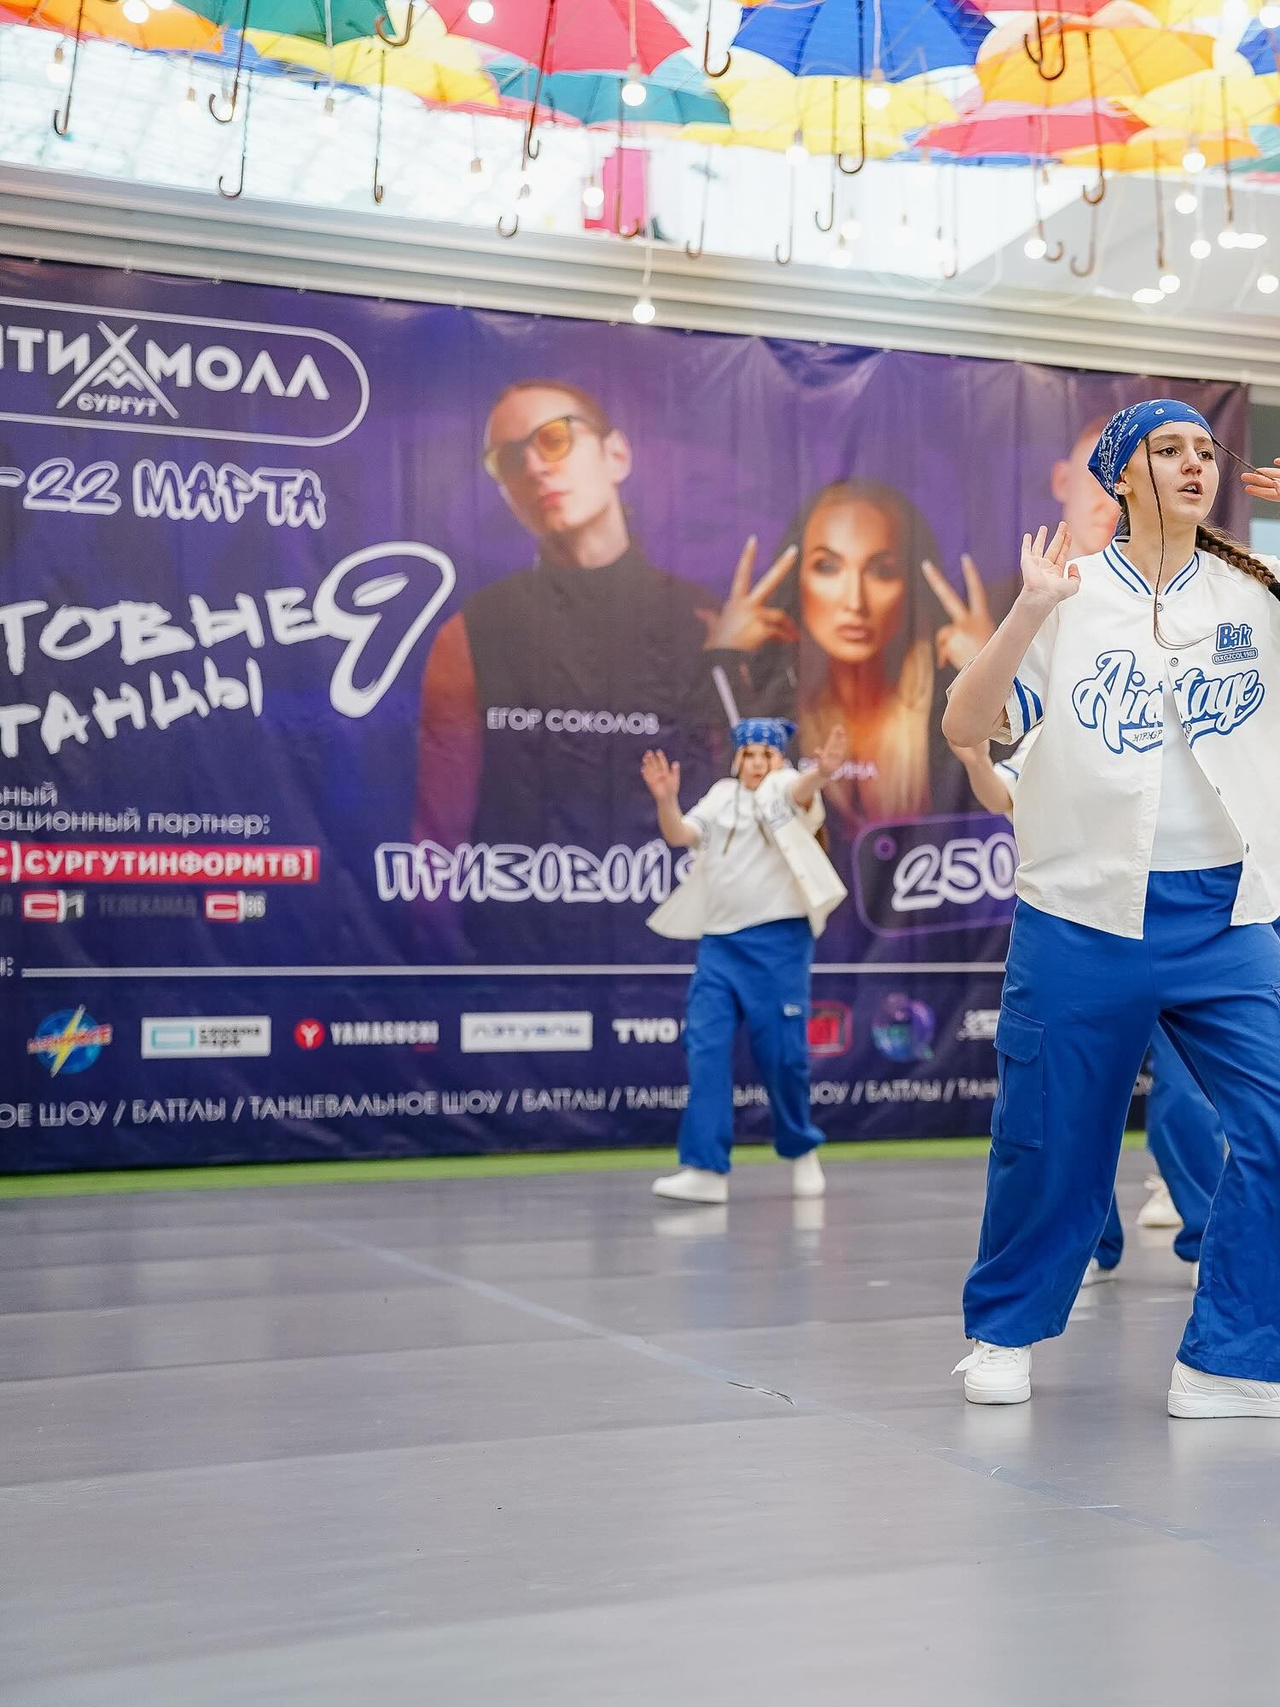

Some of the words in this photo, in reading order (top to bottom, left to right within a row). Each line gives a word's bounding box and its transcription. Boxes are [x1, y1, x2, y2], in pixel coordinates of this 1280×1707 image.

[0, 324, 91, 376] ТИ
[145, 339, 330, 400] МОЛЛ
[77, 391, 160, 418] СУРГУТ
[132, 458, 326, 530] МАРТА
[1216, 622, 1253, 652] Bak
[0, 656, 264, 758] ТАНЦЫ
[486, 706, 543, 731] ЕГОР
[544, 708, 661, 736] СОКОЛОВ
[374, 839, 672, 904] ПРИЗОВОЙ
[330, 1021, 440, 1046] YAMAGUCHI
[611, 1017, 680, 1044] TWO
[38, 1100, 107, 1127] ШОУ
[131, 1097, 226, 1124] БАТТЛЫ
[249, 1090, 438, 1121] ТАНЦЕВАЛЬНОЕ
[442, 1089, 502, 1115] ШОУ
[522, 1086, 607, 1113] БАТТЛЫ
